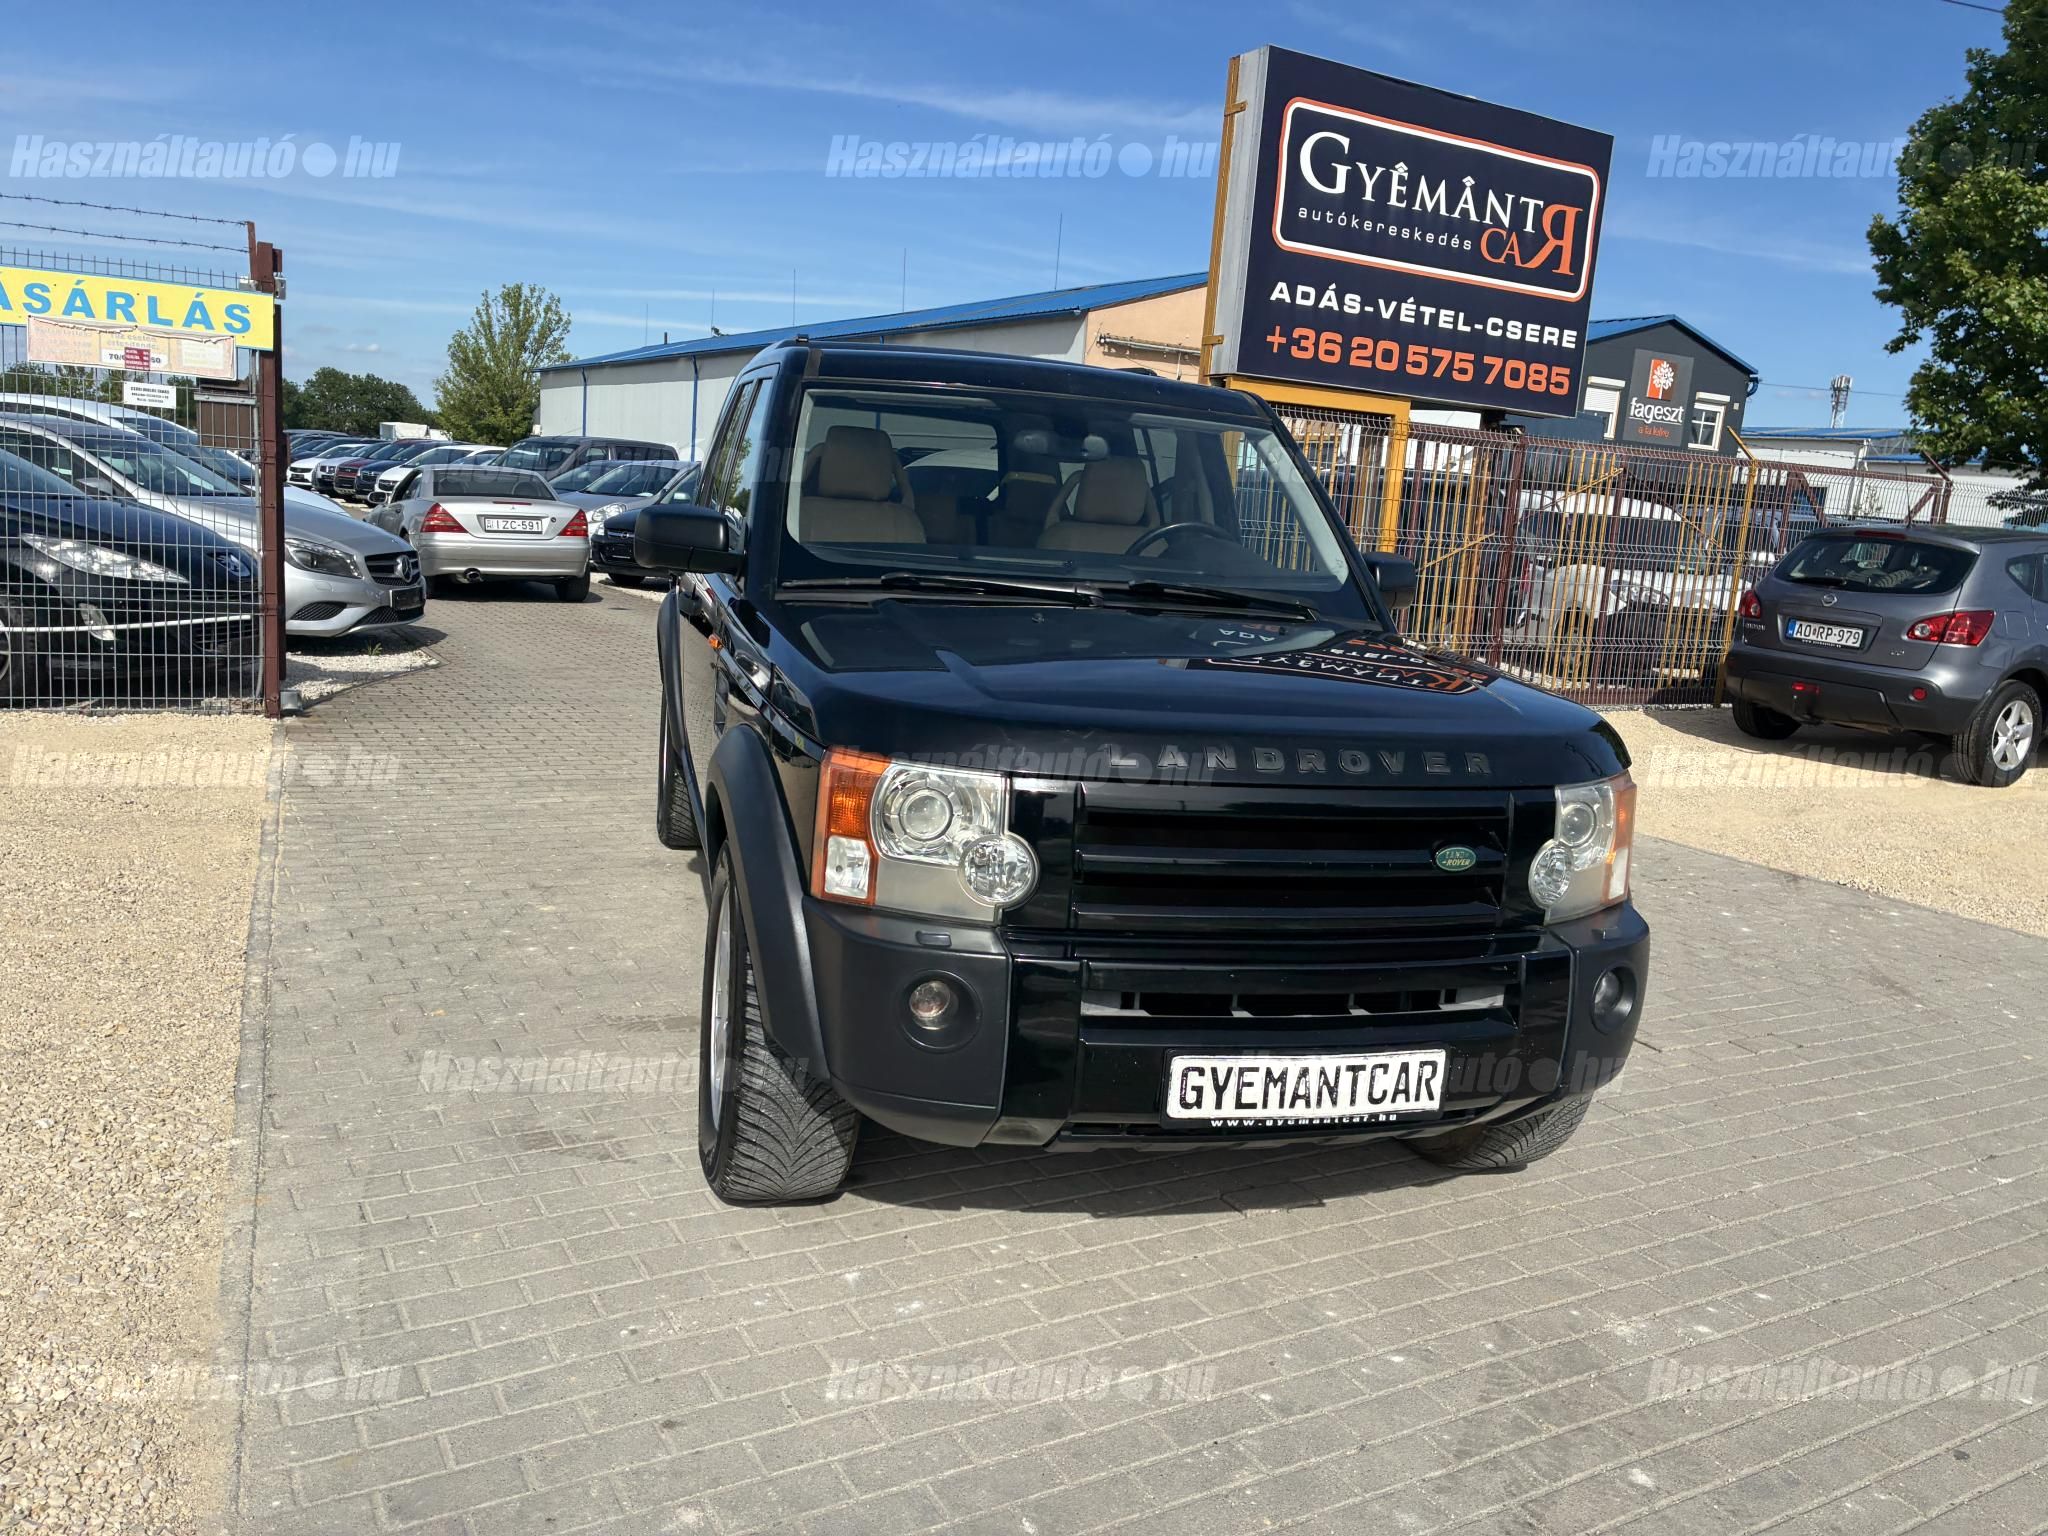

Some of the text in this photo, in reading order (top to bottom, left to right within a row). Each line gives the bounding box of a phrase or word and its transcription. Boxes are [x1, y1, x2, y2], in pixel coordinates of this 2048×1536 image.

[1298, 206, 1472, 251] autókereskedés
[1270, 281, 1577, 349] ADÁS-VÉTEL-CSERE
[1266, 325, 1571, 396] +36 20 575 7085
[1630, 397, 1685, 424] fageszt
[1179, 1060, 1439, 1111] GYEMANTCAR
